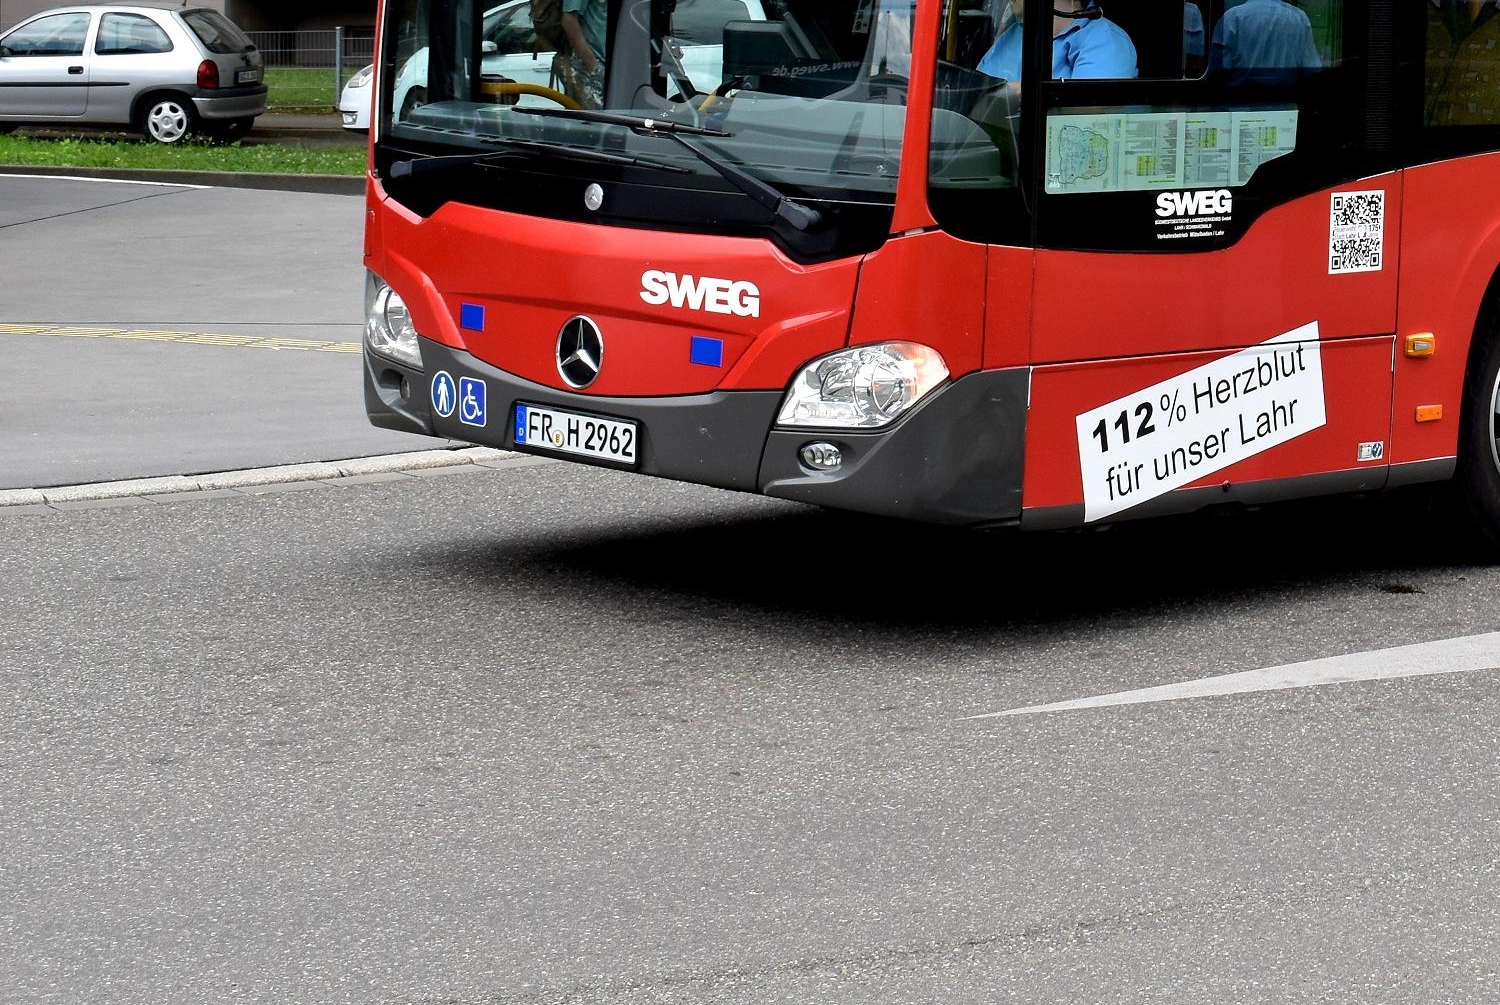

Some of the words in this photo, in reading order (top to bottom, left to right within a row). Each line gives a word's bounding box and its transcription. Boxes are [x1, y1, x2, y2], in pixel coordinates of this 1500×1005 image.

[1154, 188, 1233, 217] SWEG
[1368, 224, 1379, 232] 175
[639, 269, 760, 318] SWEG
[1193, 344, 1306, 414] Herzblut
[583, 421, 634, 458] 2962
[1105, 462, 1144, 501] für
[1153, 428, 1229, 481] unser
[1239, 399, 1300, 446] Lahr
